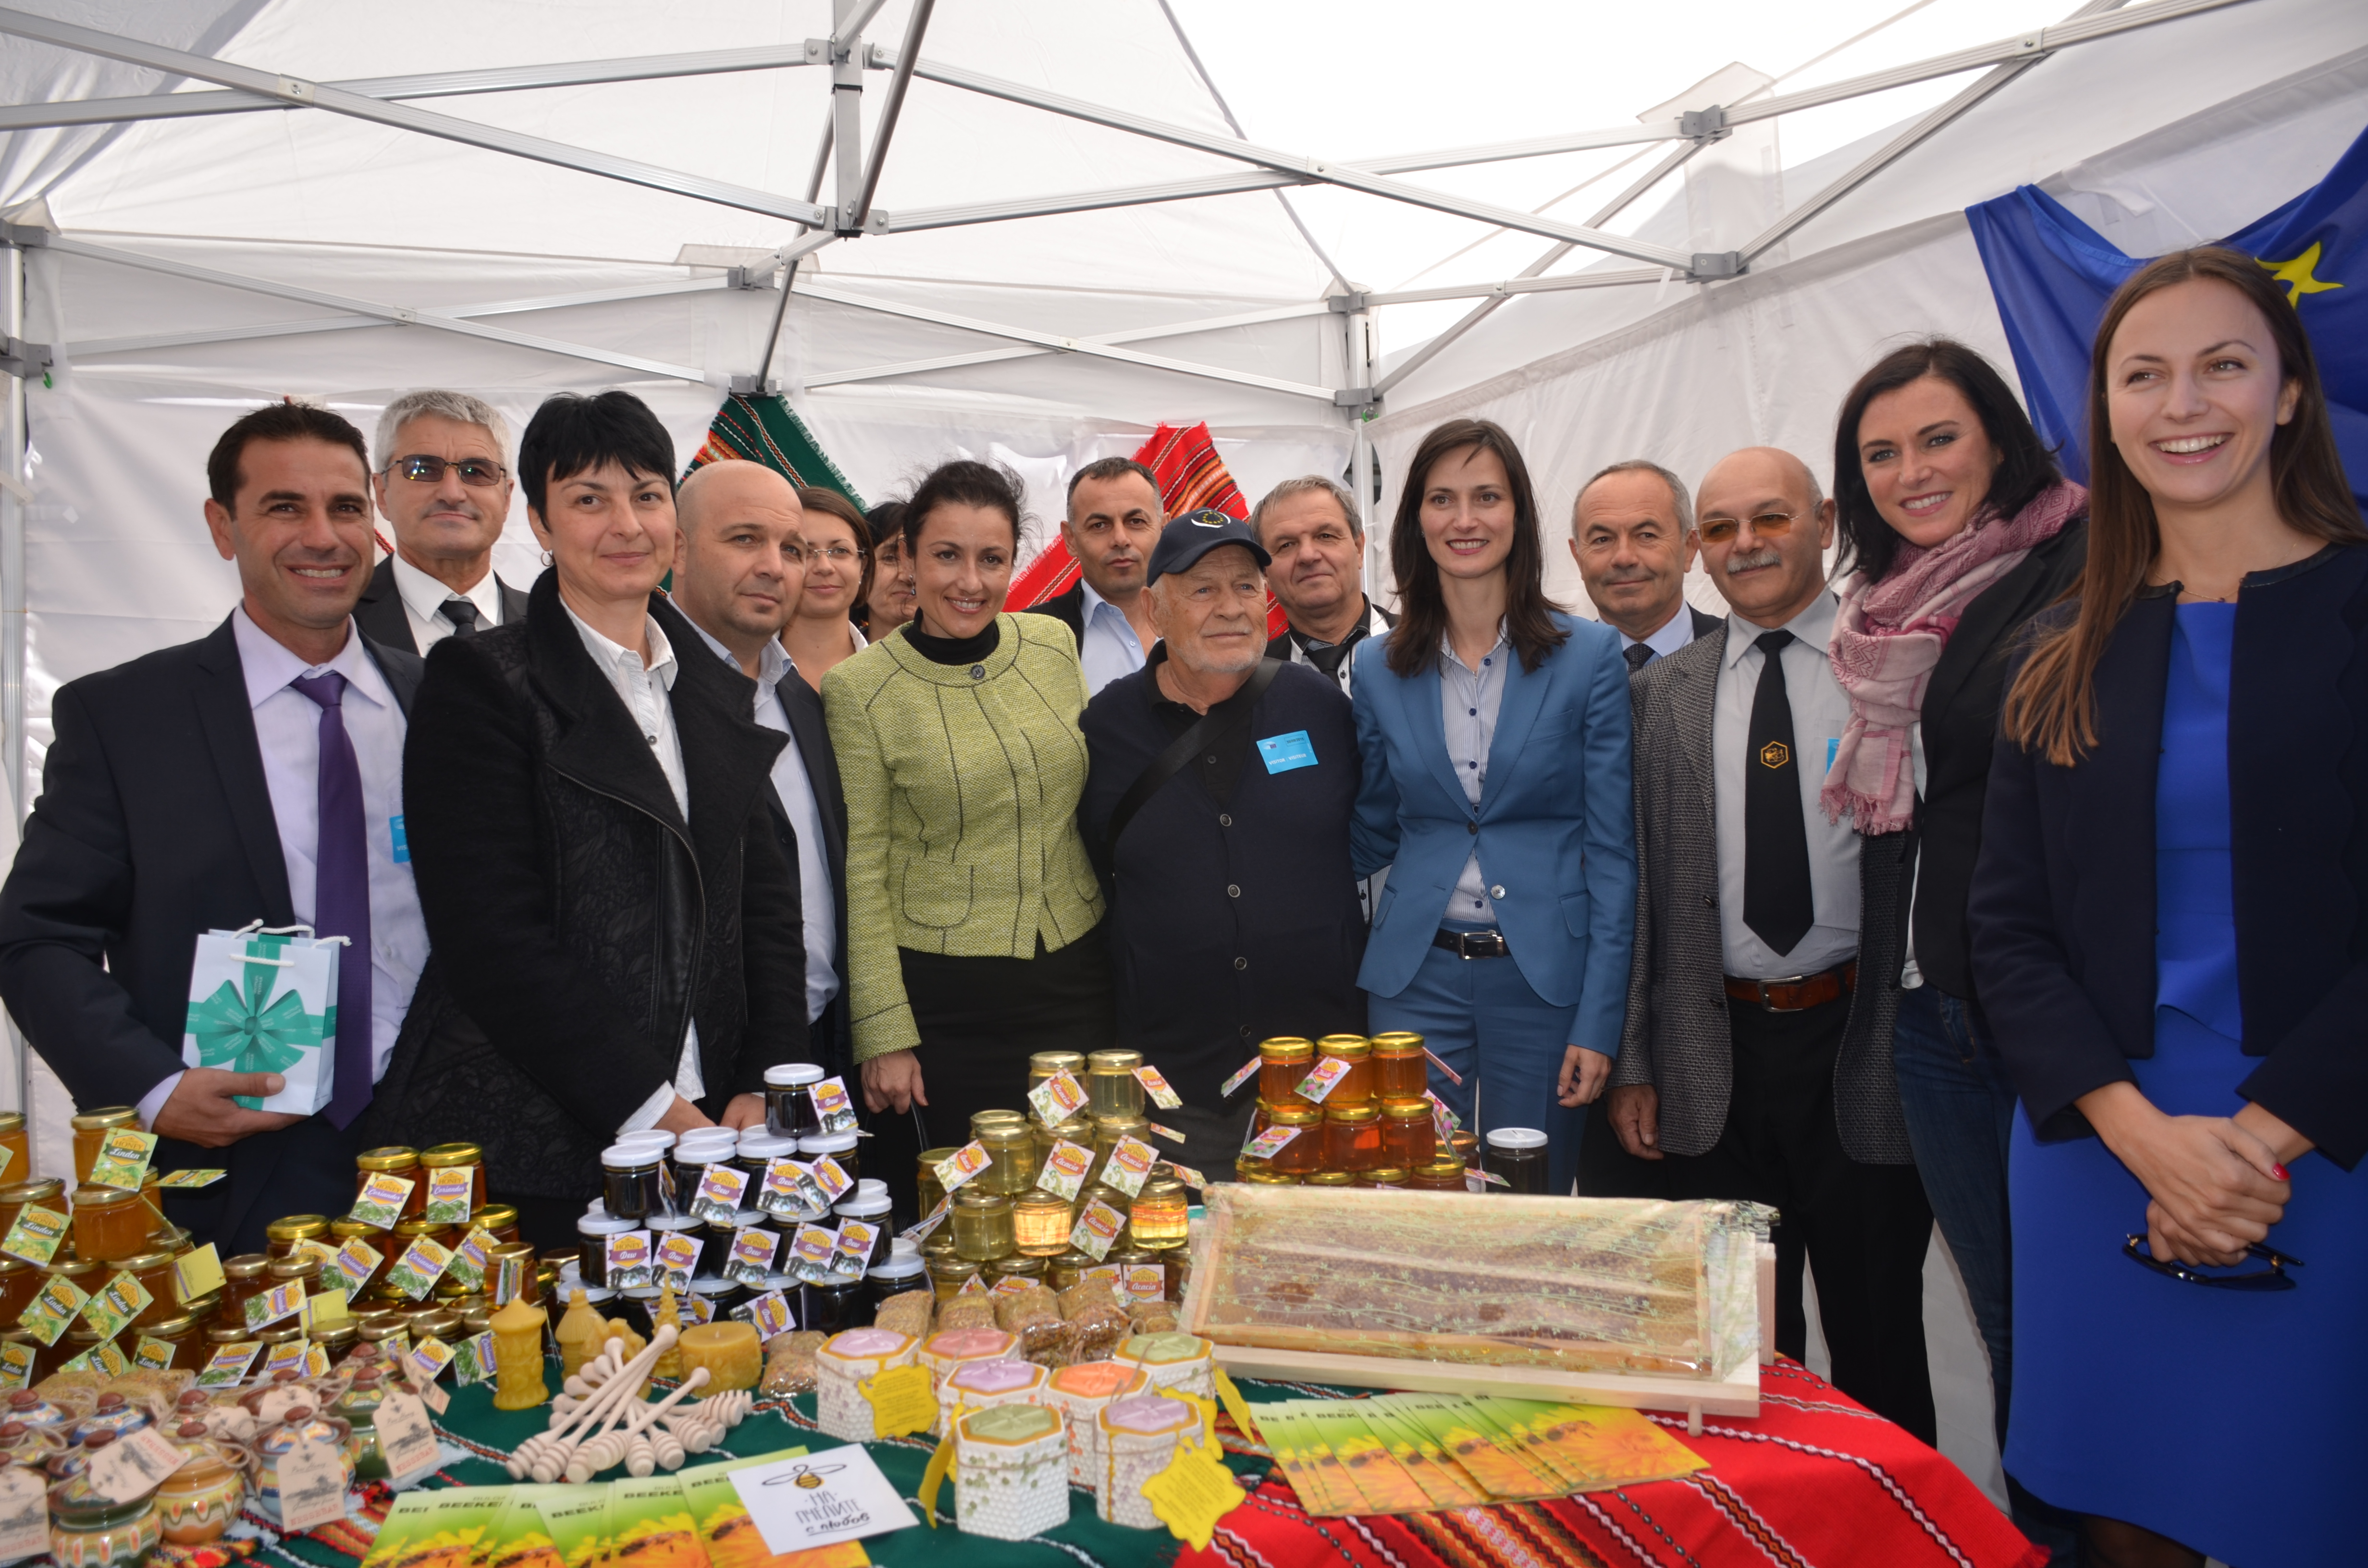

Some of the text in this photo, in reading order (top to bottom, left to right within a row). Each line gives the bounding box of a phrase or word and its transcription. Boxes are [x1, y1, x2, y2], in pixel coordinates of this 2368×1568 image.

[818, 1089, 839, 1099] HONEY
[1053, 1083, 1071, 1106] Acacia
[1061, 1079, 1077, 1100] HONEY
[825, 1097, 839, 1106] Dew
[115, 1140, 143, 1152] HONEY
[109, 1148, 140, 1159] Linden
[1061, 1150, 1082, 1164] HONEY
[1125, 1146, 1148, 1161] HONEY
[1056, 1158, 1079, 1172] Acacia
[1120, 1153, 1144, 1170] Acacia
[713, 1176, 737, 1187] HONEY
[777, 1177, 794, 1186] Dew
[820, 1172, 833, 1187] Dew
[824, 1164, 841, 1185] HONEY
[369, 1189, 400, 1200] Coriander
[376, 1183, 400, 1193] HONEY
[434, 1185, 464, 1194] Coriander
[713, 1184, 730, 1195] Dew
[30, 1215, 59, 1228] HONEY
[1093, 1210, 1114, 1225] HONEY
[24, 1220, 54, 1237] Linden
[1088, 1217, 1110, 1234] Acacia
[804, 1235, 829, 1246] HONEY
[845, 1230, 867, 1241] HONEY
[668, 1243, 691, 1255] HONEY
[744, 1237, 768, 1249] HONEY
[805, 1244, 822, 1254] Dew
[845, 1238, 860, 1248] Dew
[349, 1249, 370, 1266] HONEY
[419, 1247, 441, 1263] HONEY
[620, 1251, 637, 1259] Dew
[668, 1252, 684, 1262] Dew
[745, 1246, 761, 1256] Dew
[339, 1254, 366, 1274] Coriander
[408, 1252, 437, 1273] Coriander
[1131, 1282, 1157, 1291] Acacia
[52, 1288, 74, 1306] HONEY
[109, 1290, 129, 1313] Linden
[118, 1284, 138, 1305] HONEY
[44, 1295, 68, 1315] Linden
[762, 1309, 772, 1325] Dew
[769, 1301, 782, 1325] HONEY
[141, 1349, 164, 1361] HONEY
[215, 1356, 247, 1364] Coriander
[414, 1352, 437, 1370] Coriander
[481, 1338, 494, 1370] Coriander
[2, 1362, 22, 1375] Linden
[91, 1355, 109, 1373] Lind
[101, 1350, 119, 1375] HONEY
[268, 1358, 298, 1371] Coriander
[795, 1498, 863, 1524] ПЧЕЛИТЕ
[0, 1536, 43, 1555] ESSEBAR
